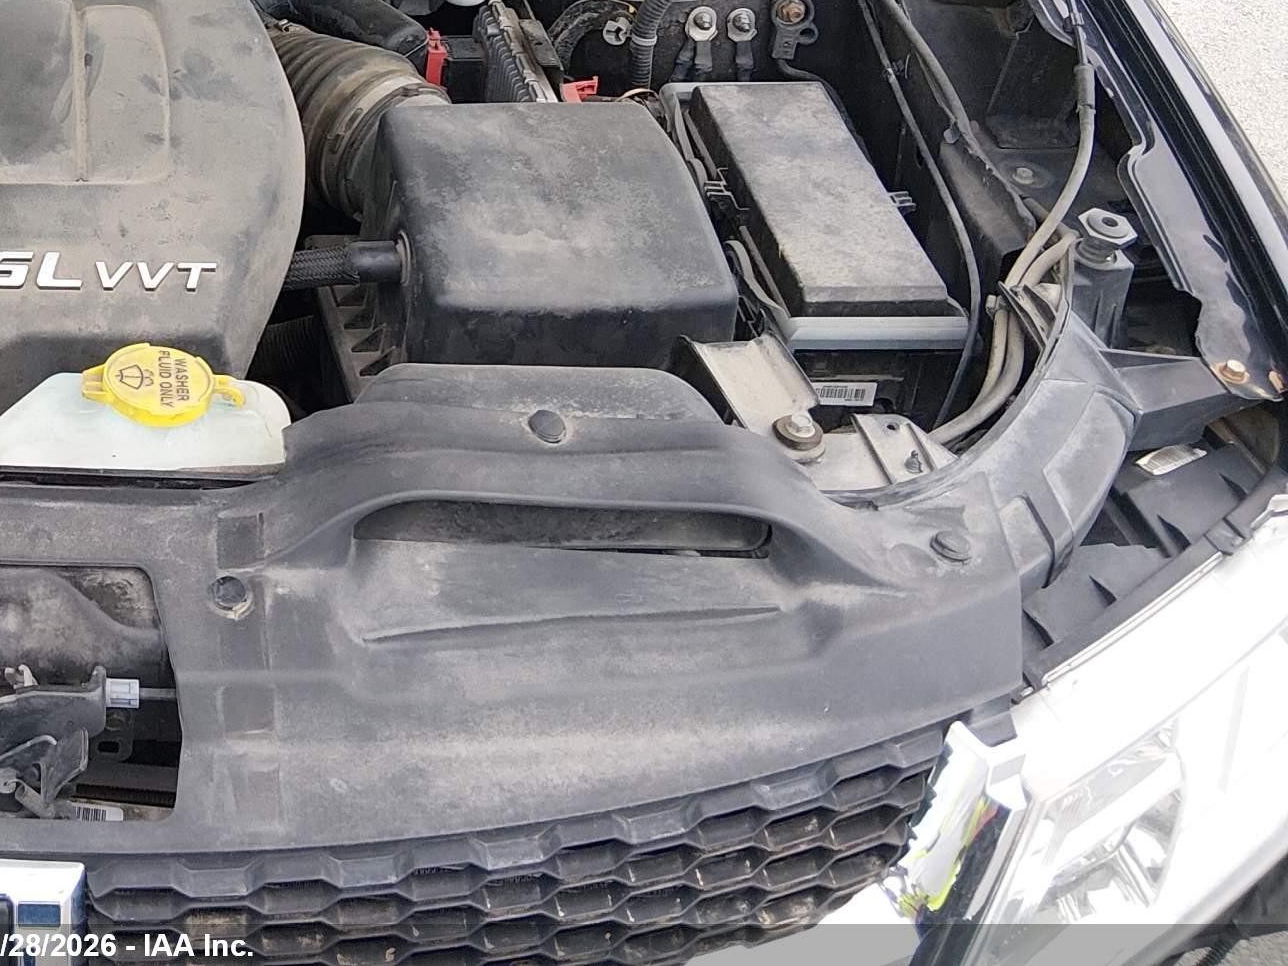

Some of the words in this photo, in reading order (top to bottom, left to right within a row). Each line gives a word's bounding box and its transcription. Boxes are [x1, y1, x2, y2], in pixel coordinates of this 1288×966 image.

[95, 261, 217, 291] VVT
[158, 350, 172, 380] FLUID
[174, 357, 190, 402] WASHER
[159, 381, 175, 408] ONLY
